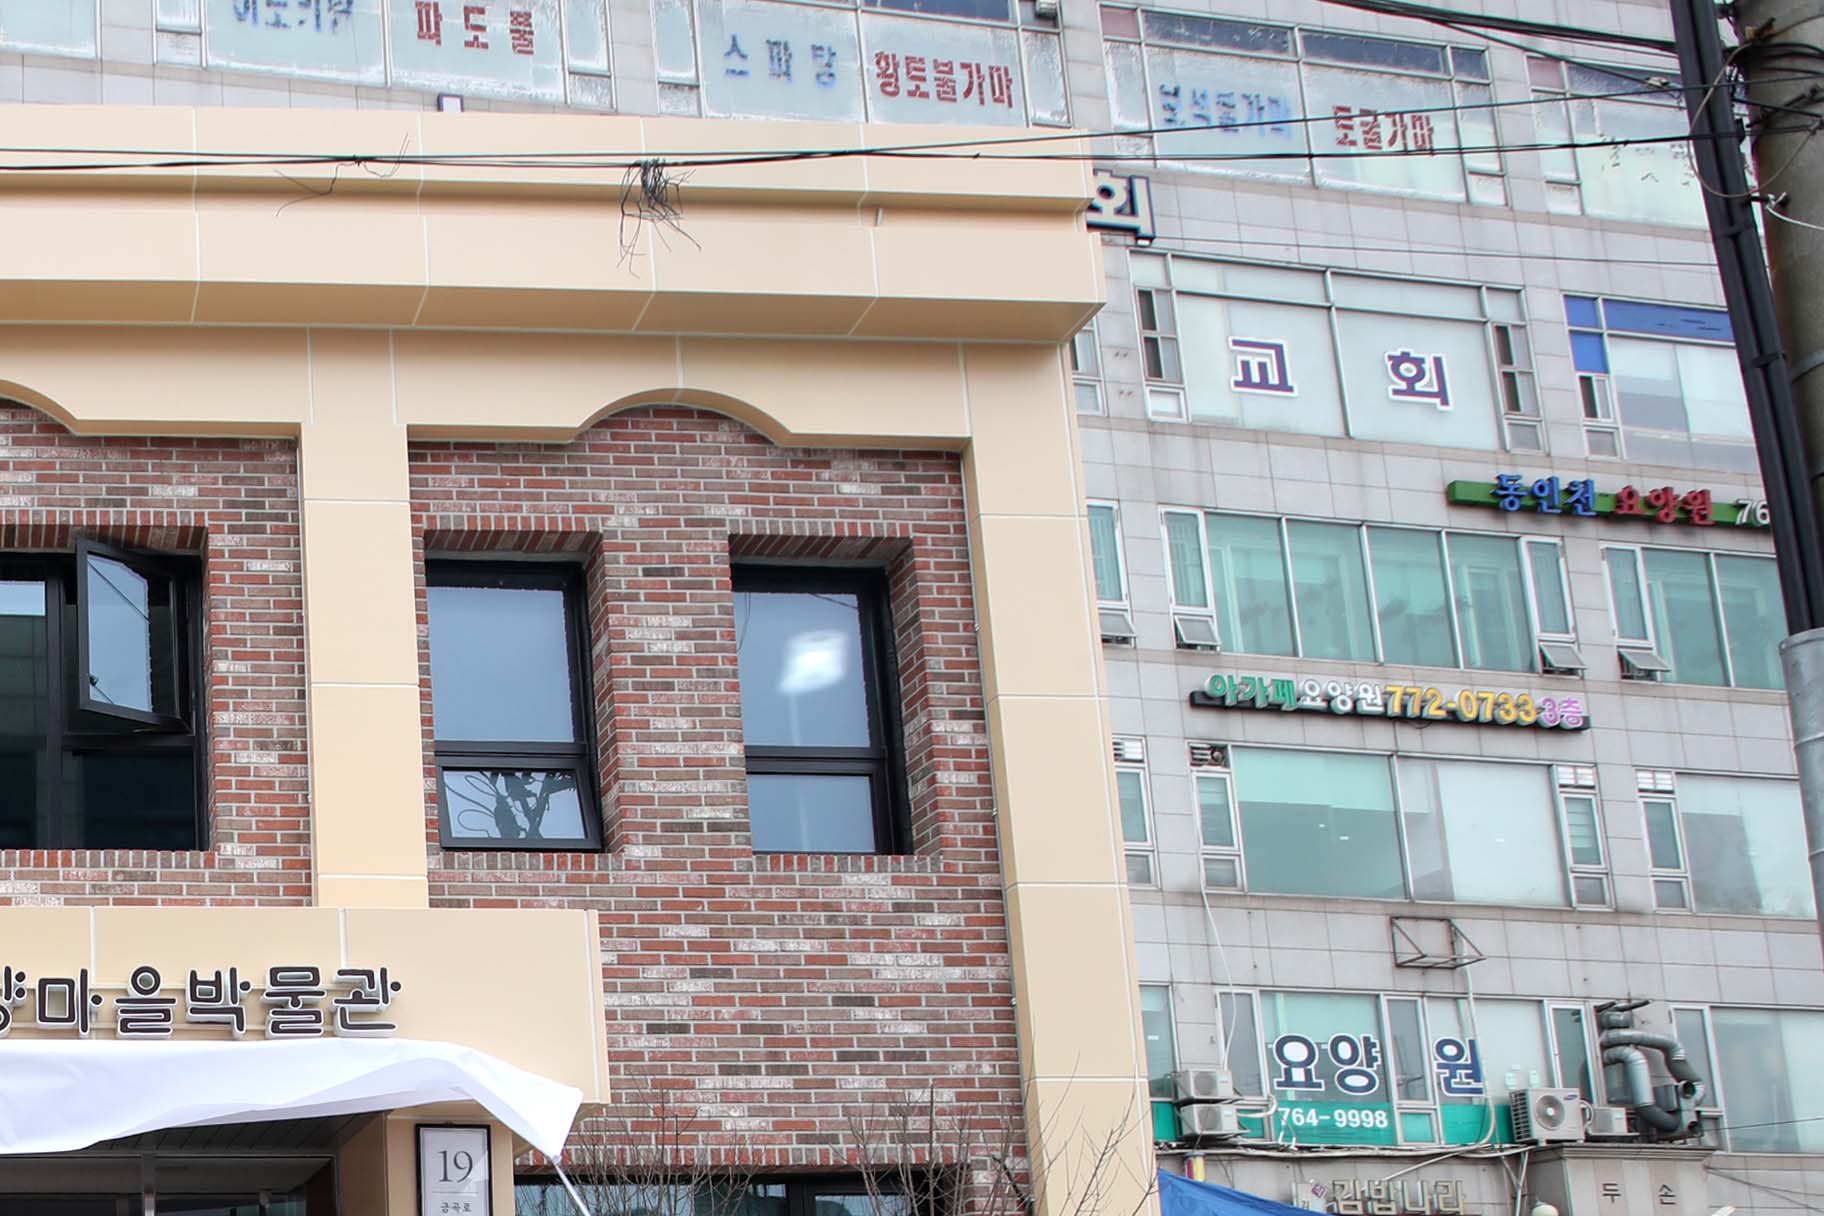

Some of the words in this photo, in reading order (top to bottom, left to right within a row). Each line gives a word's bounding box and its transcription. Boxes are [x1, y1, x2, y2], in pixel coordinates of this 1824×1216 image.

[874, 50, 1014, 109] 황토불가마
[1493, 472, 1597, 517] 동인천
[1614, 485, 1715, 526] 요양원
[1278, 1107, 1390, 1129] 764-9998
[437, 1150, 474, 1183] 19
